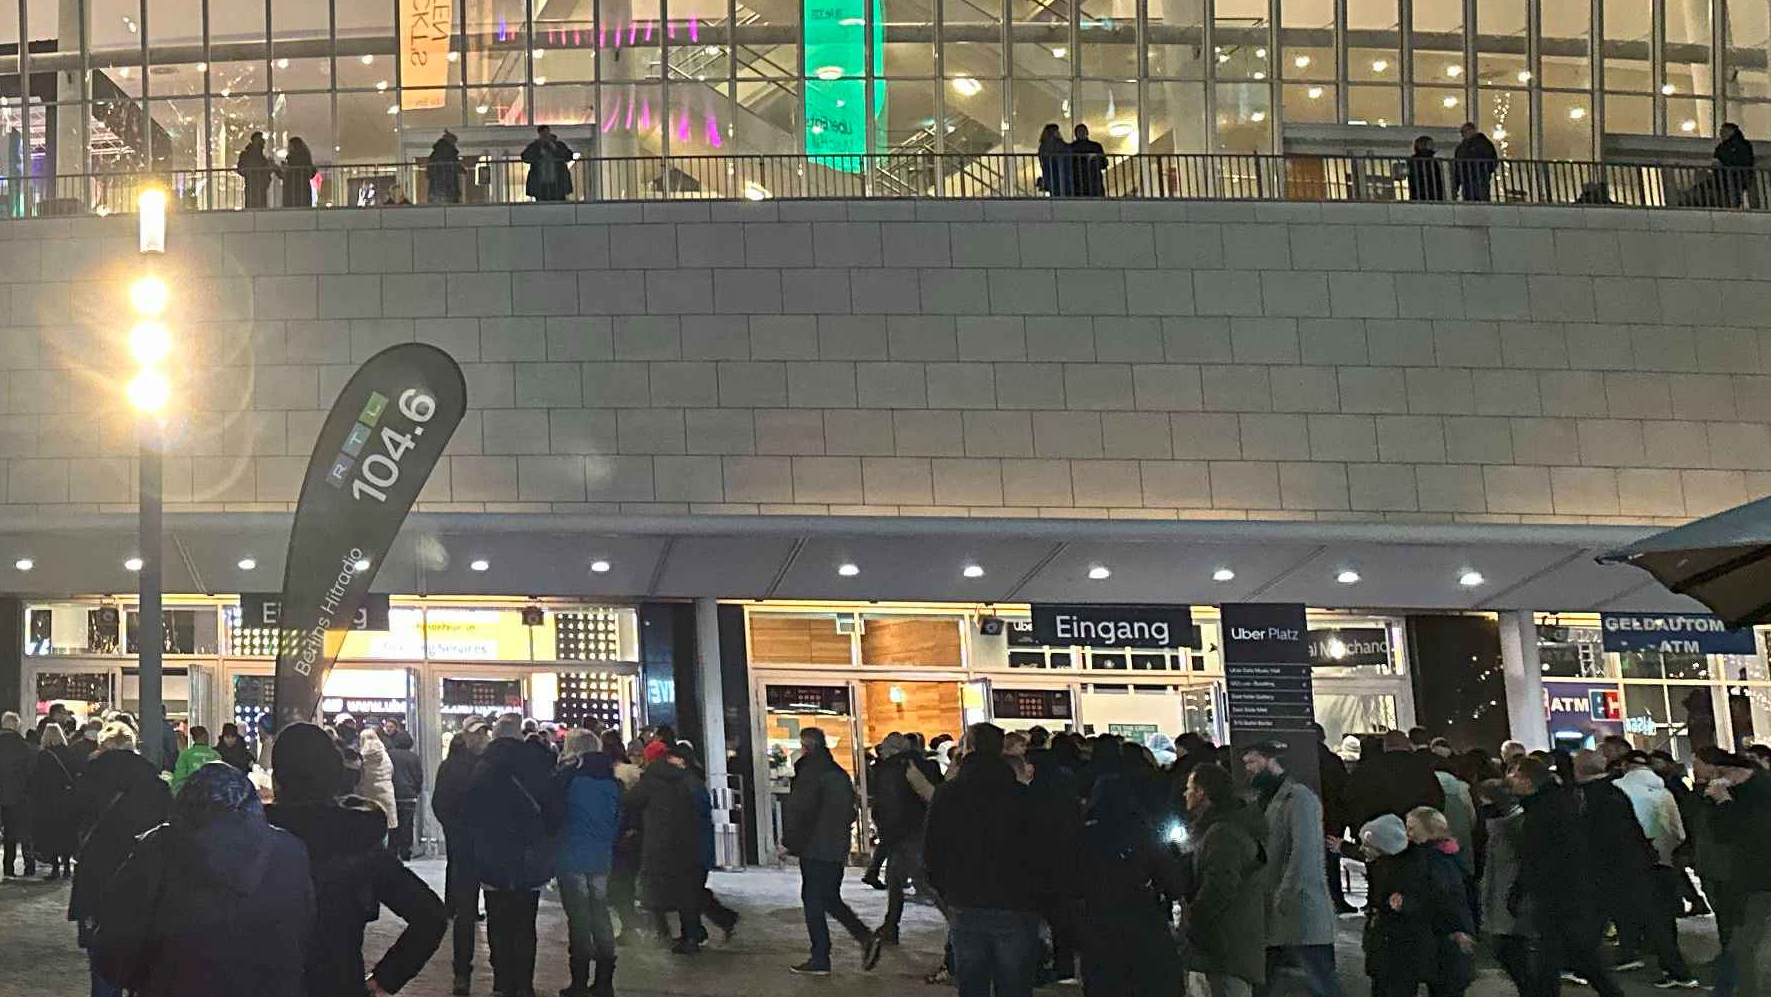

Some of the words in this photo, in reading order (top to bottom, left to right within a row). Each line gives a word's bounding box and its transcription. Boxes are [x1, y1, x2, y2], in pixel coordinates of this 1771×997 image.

[330, 400, 384, 482] RTL
[352, 388, 436, 503] 104.6
[294, 616, 331, 677] Berlins
[320, 547, 364, 616] Hitradio
[1013, 619, 1033, 632] Ube
[1055, 615, 1170, 646] Eingang
[1605, 616, 1725, 633] GELDAUTOM
[1231, 627, 1266, 641] Uber
[1268, 627, 1299, 641] Platz
[1659, 640, 1700, 653] ATM
[1550, 697, 1590, 712] ATM
